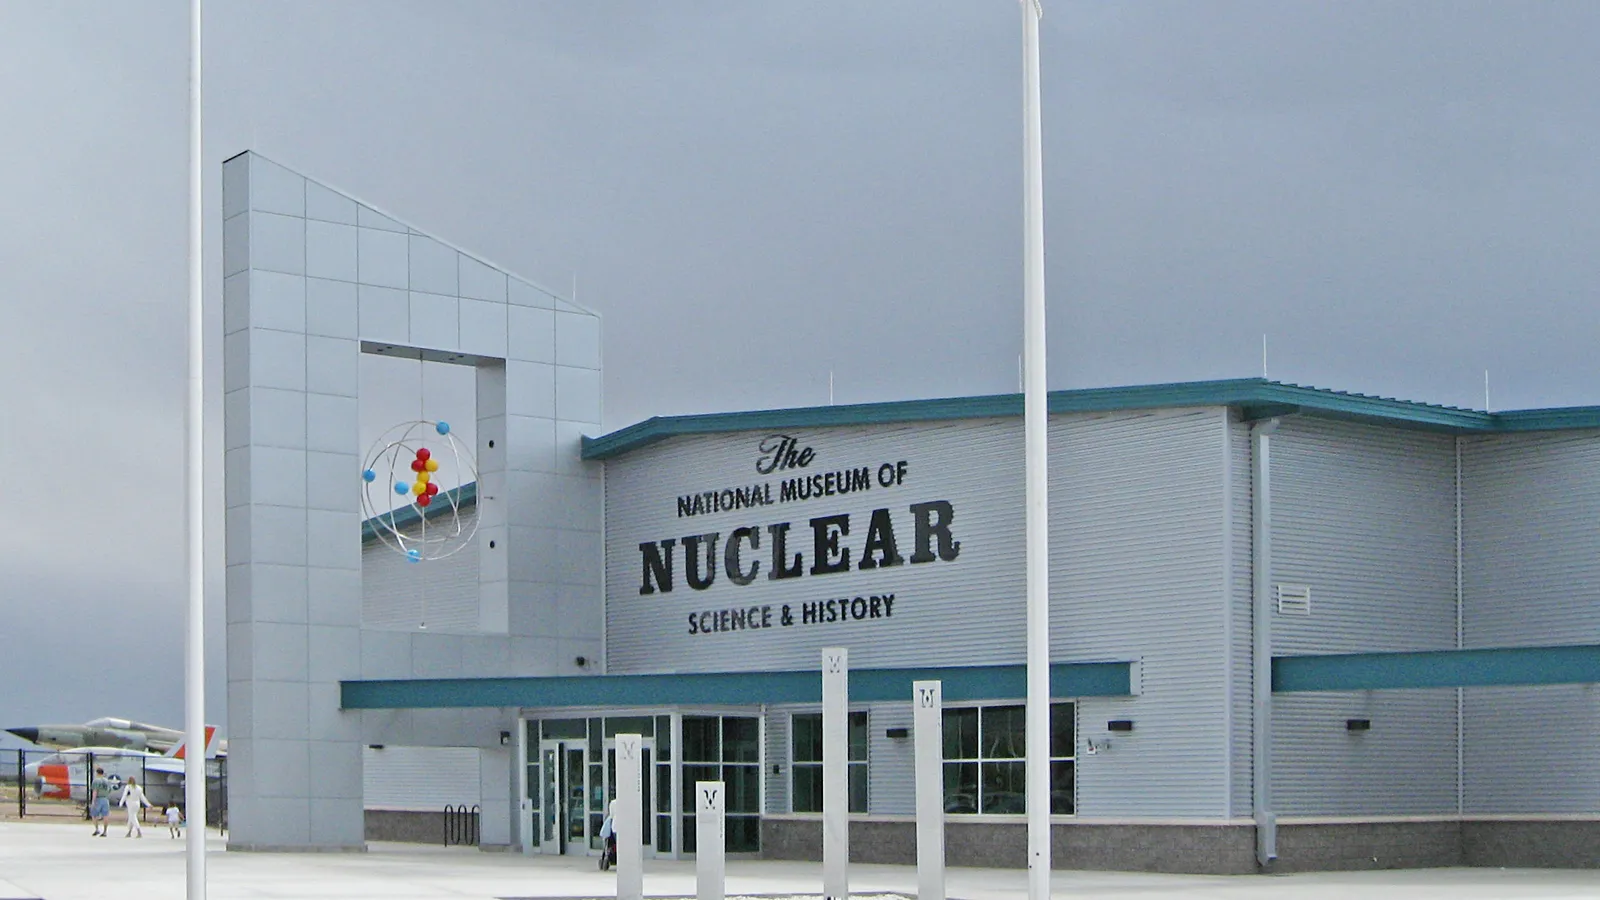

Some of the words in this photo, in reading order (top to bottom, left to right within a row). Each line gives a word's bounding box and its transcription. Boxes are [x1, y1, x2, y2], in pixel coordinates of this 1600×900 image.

[756, 434, 815, 474] The
[677, 483, 774, 517] NATIONAL
[780, 466, 870, 502] MUSEUM
[878, 460, 908, 487] OF
[639, 500, 961, 595] NUCLEAR
[688, 606, 771, 634] SCIENCE
[781, 605, 793, 626] &
[802, 594, 895, 624] HISTORY
